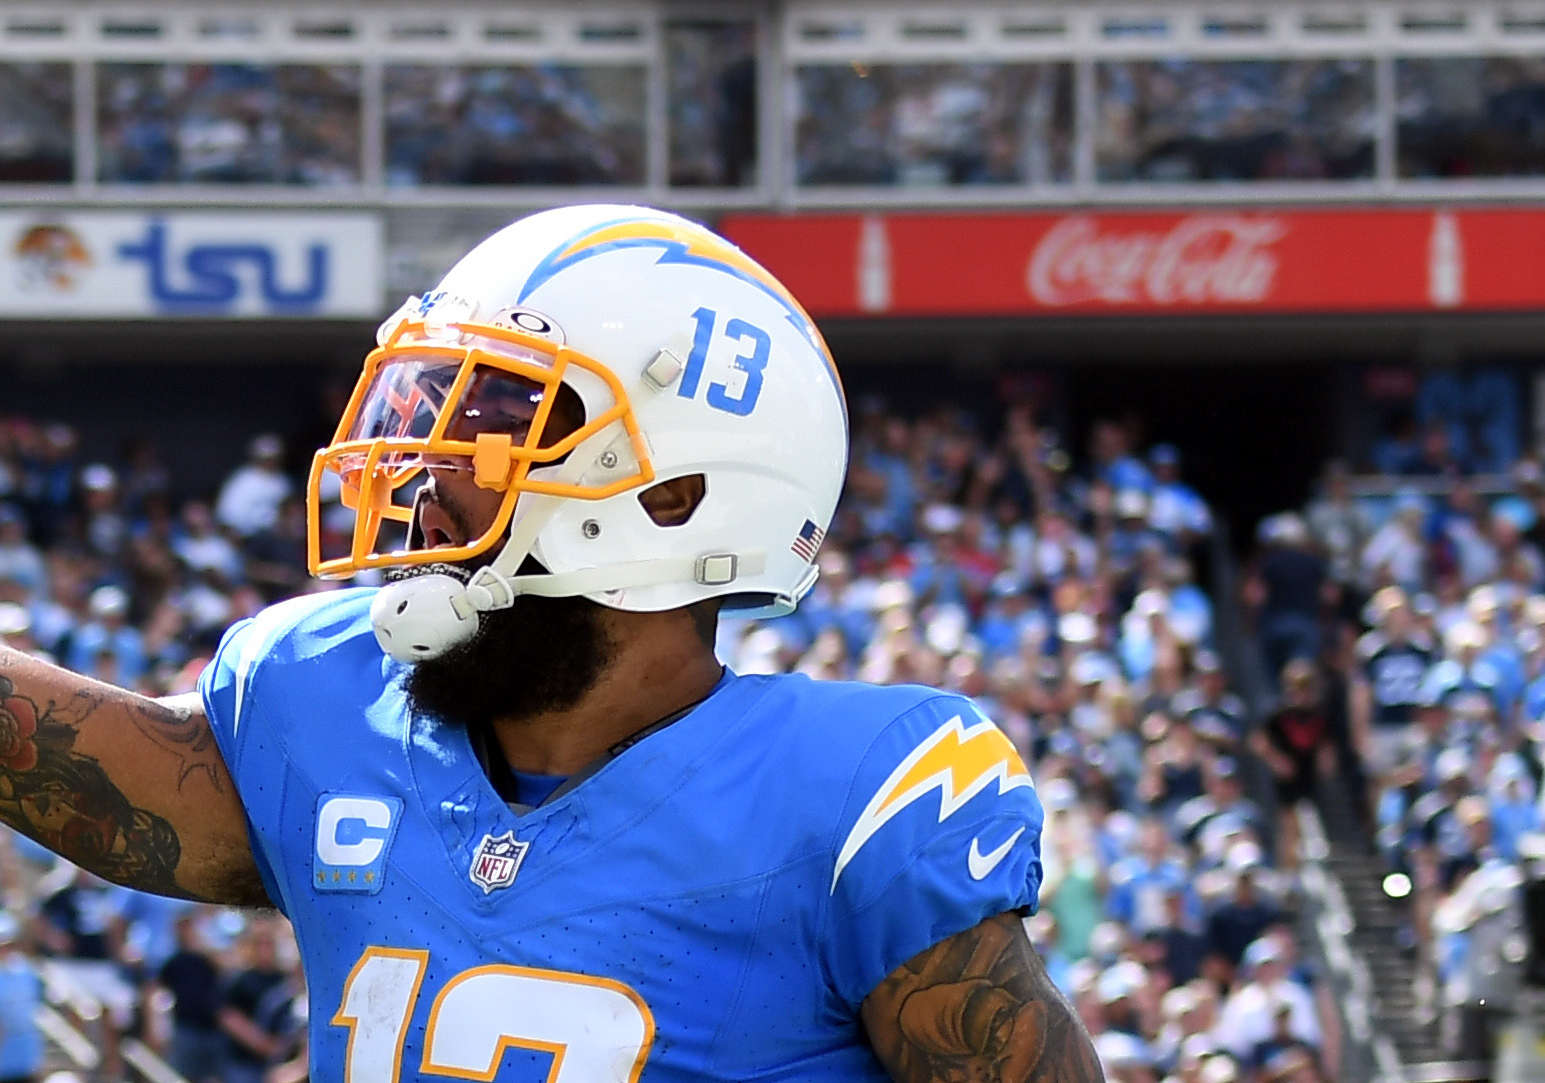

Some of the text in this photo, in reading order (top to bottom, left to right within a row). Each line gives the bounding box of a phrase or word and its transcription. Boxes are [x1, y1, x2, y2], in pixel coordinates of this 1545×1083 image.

[116, 214, 328, 308] tsu
[1025, 213, 1289, 306] Coca-Cola
[676, 305, 772, 417] 13
[316, 797, 391, 866] C
[475, 856, 509, 881] NFL
